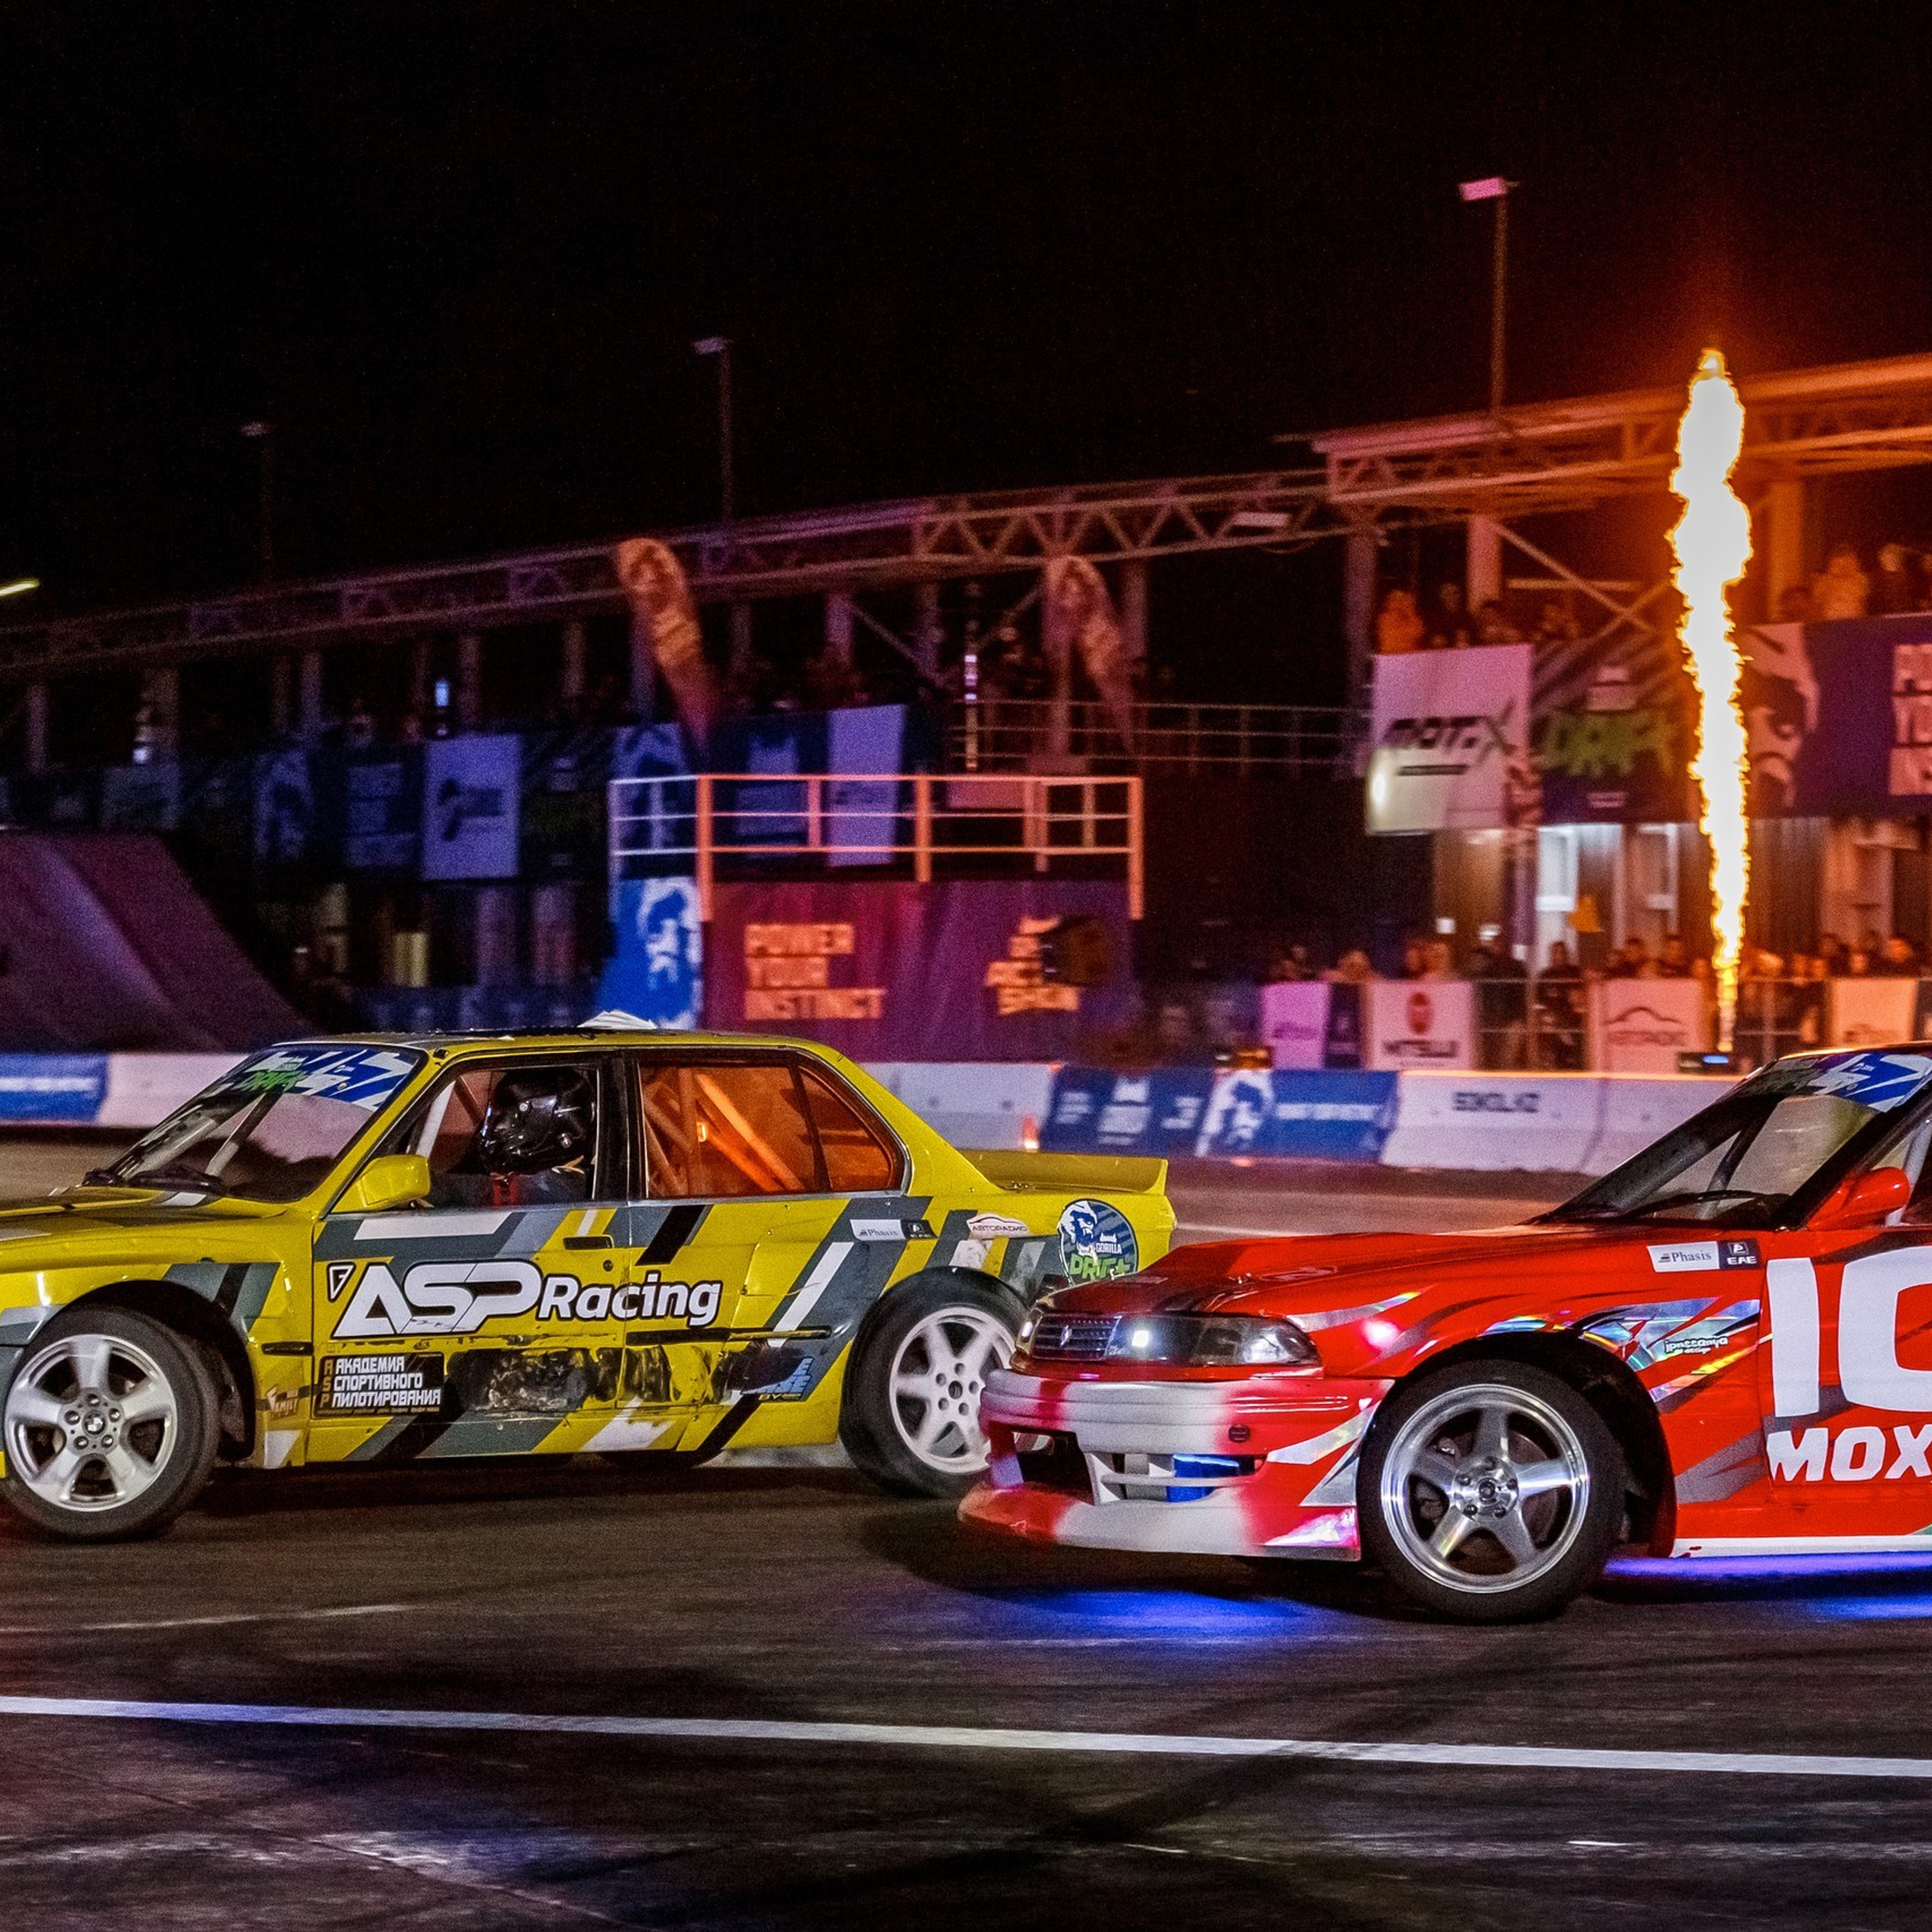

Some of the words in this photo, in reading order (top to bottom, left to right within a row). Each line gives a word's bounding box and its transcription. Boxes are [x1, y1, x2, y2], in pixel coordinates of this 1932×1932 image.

[1095, 1242, 1122, 1254] GORILLA
[1671, 1250, 1712, 1263] Phasis
[332, 1262, 541, 1337] ASP
[537, 1272, 721, 1327] Racing
[336, 1356, 405, 1374] АКАДЕМИЯ
[334, 1373, 423, 1392] СПОРТИВНОГО
[331, 1389, 441, 1408] ПИЛОТИРОВАНИЯ
